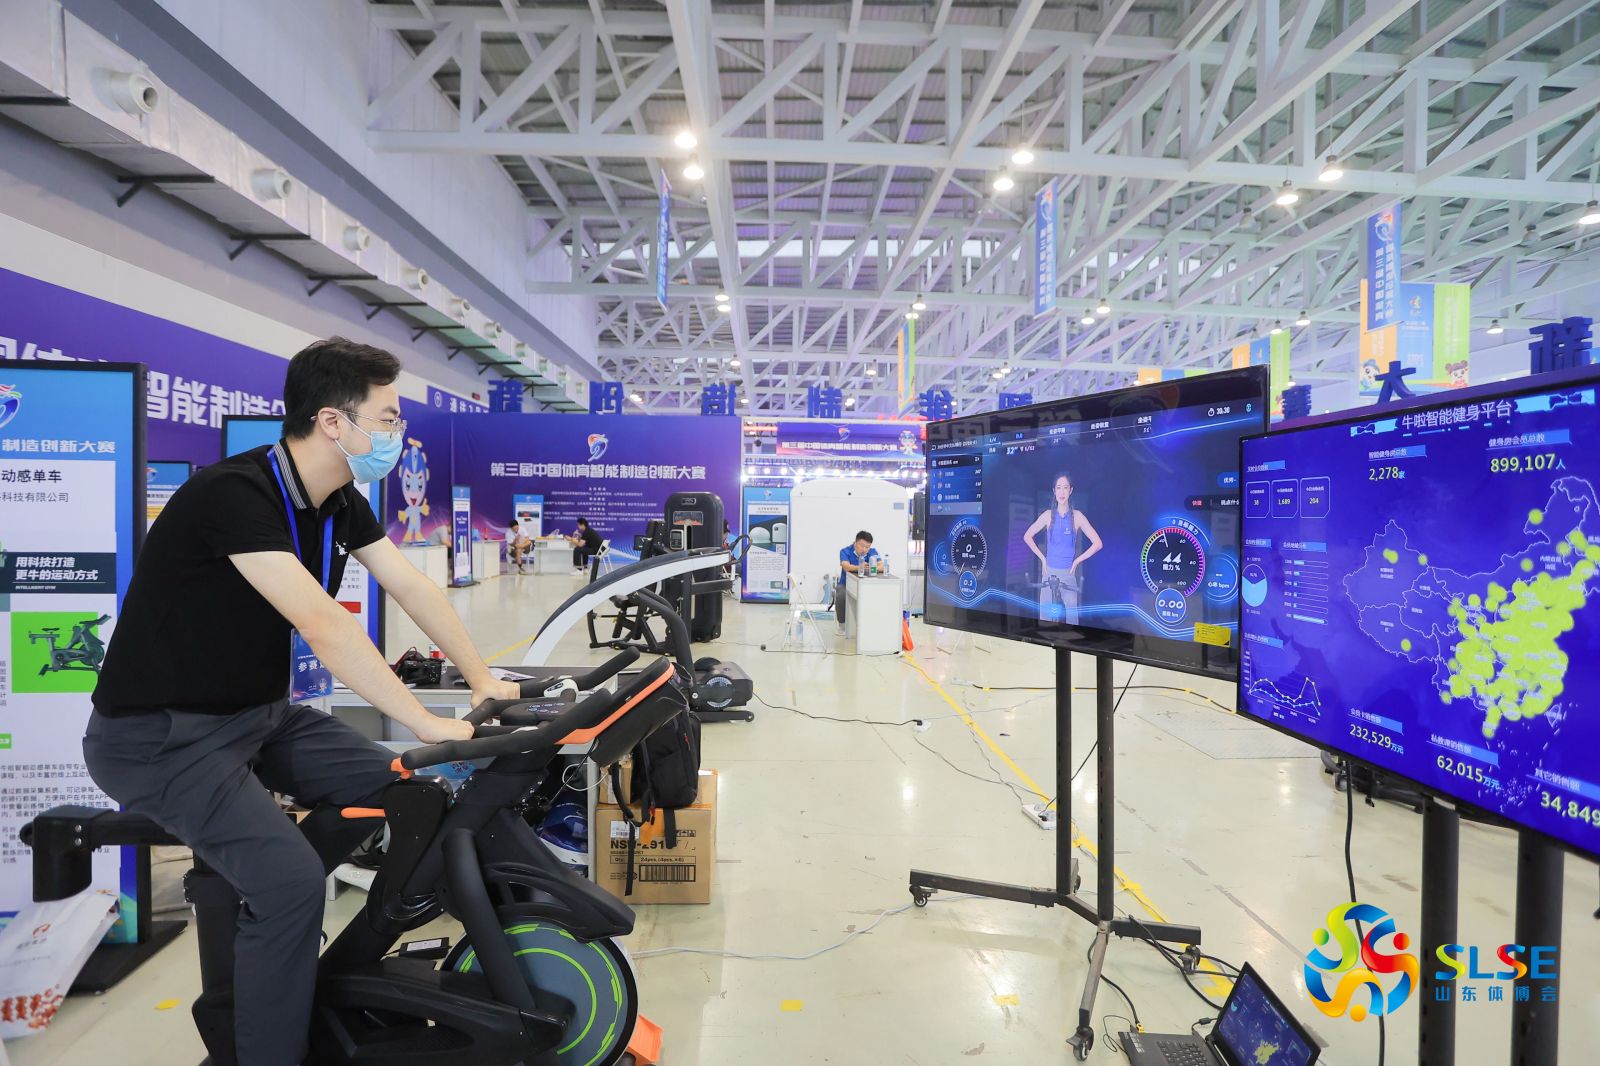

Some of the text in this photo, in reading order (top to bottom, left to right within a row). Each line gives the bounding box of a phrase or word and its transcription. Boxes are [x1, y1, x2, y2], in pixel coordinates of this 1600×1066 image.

[1401, 402, 1512, 430] 牛啦智能健身平台
[2, 439, 116, 453] 制造创新大赛
[1489, 433, 1545, 448] 健身房会员总数
[1, 469, 62, 483] 动感单车
[490, 462, 706, 480] 第三届中国体育智能制造创新大赛
[0, 492, 69, 503] 科技有限公司
[15, 556, 76, 568] 用科技打造
[15, 569, 99, 581] 更牛的运动方式
[1158, 599, 1184, 609] 0.00
[1349, 723, 1404, 755] 232,529万元
[1437, 755, 1500, 790] 62,015万元
[1541, 791, 1600, 828] 34,849
